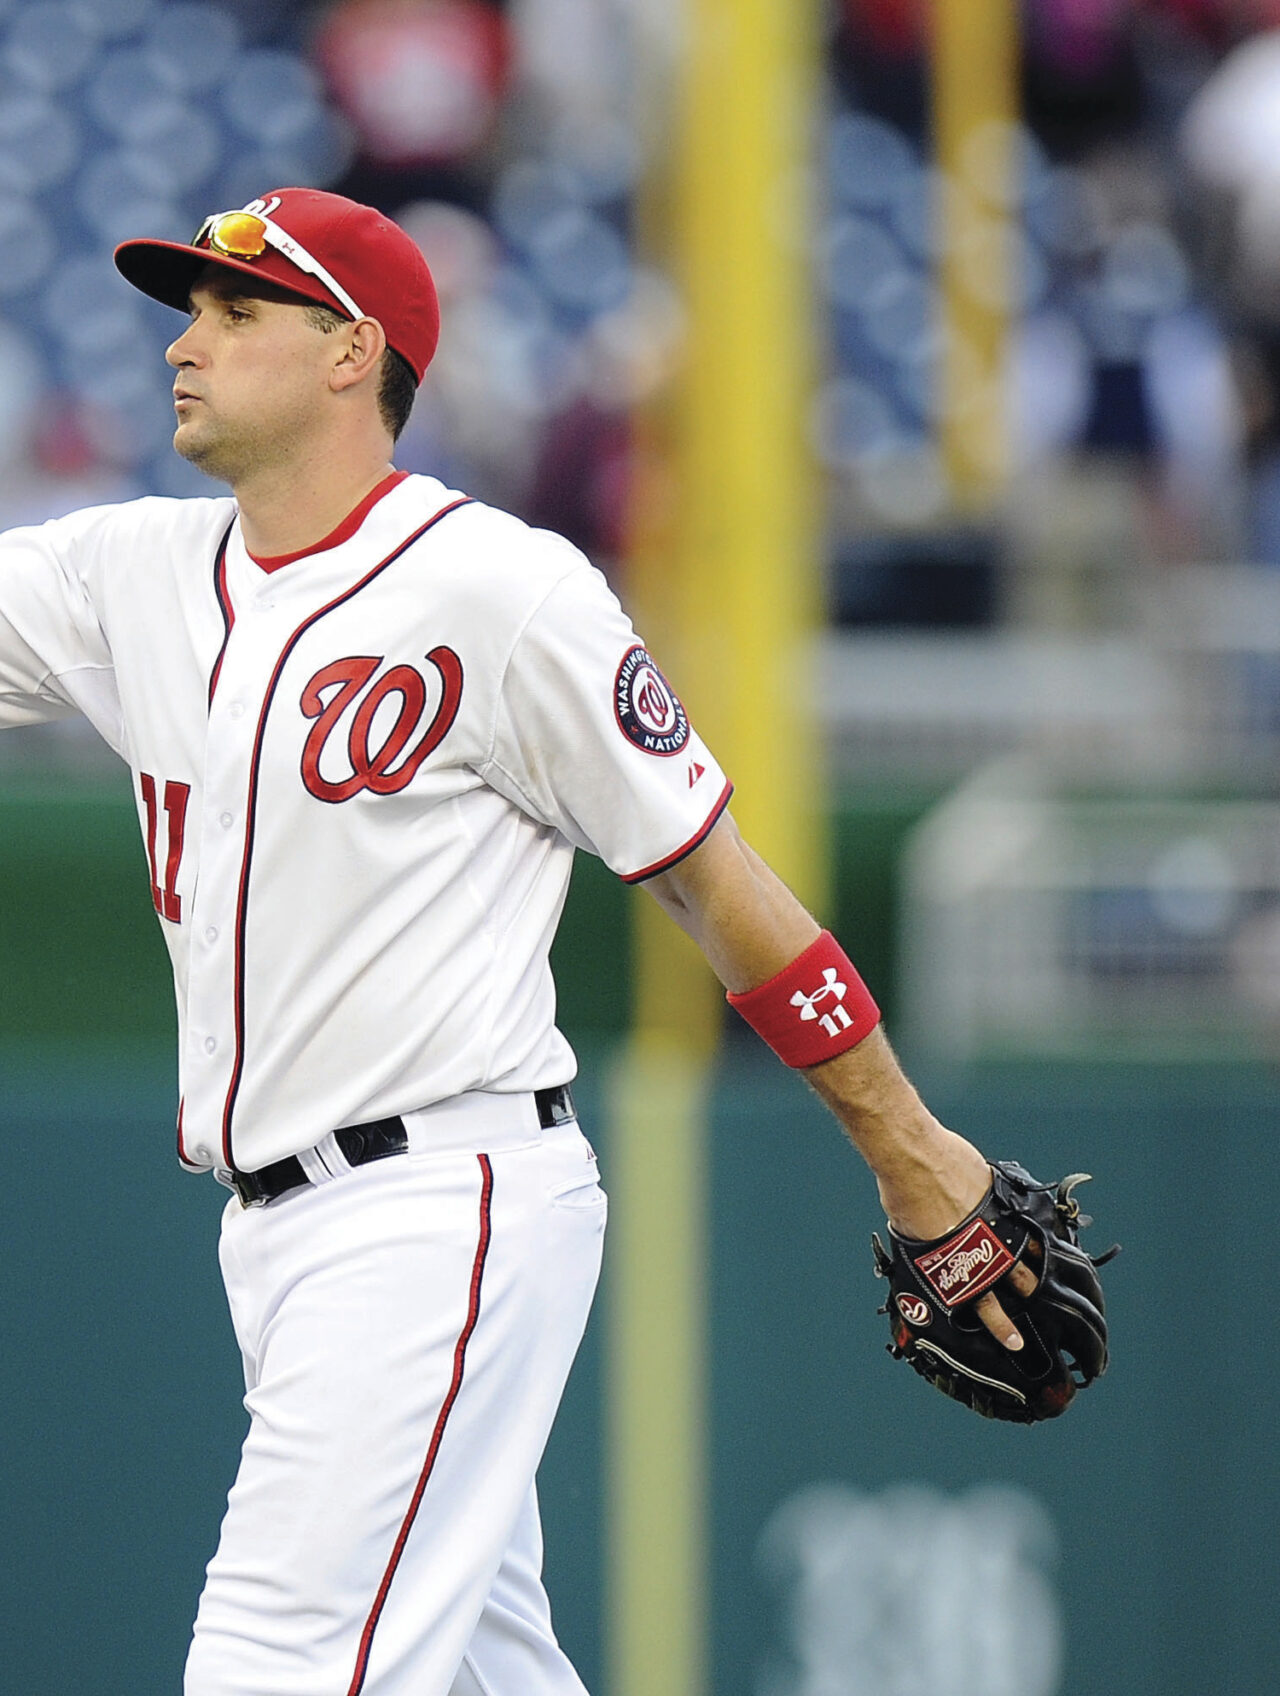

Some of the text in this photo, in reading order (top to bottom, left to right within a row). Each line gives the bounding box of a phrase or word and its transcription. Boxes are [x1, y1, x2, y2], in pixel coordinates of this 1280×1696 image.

[300, 645, 463, 804] W
[139, 771, 191, 924] 11
[818, 1003, 855, 1038] 11
[938, 1238, 994, 1291] Rawlings
